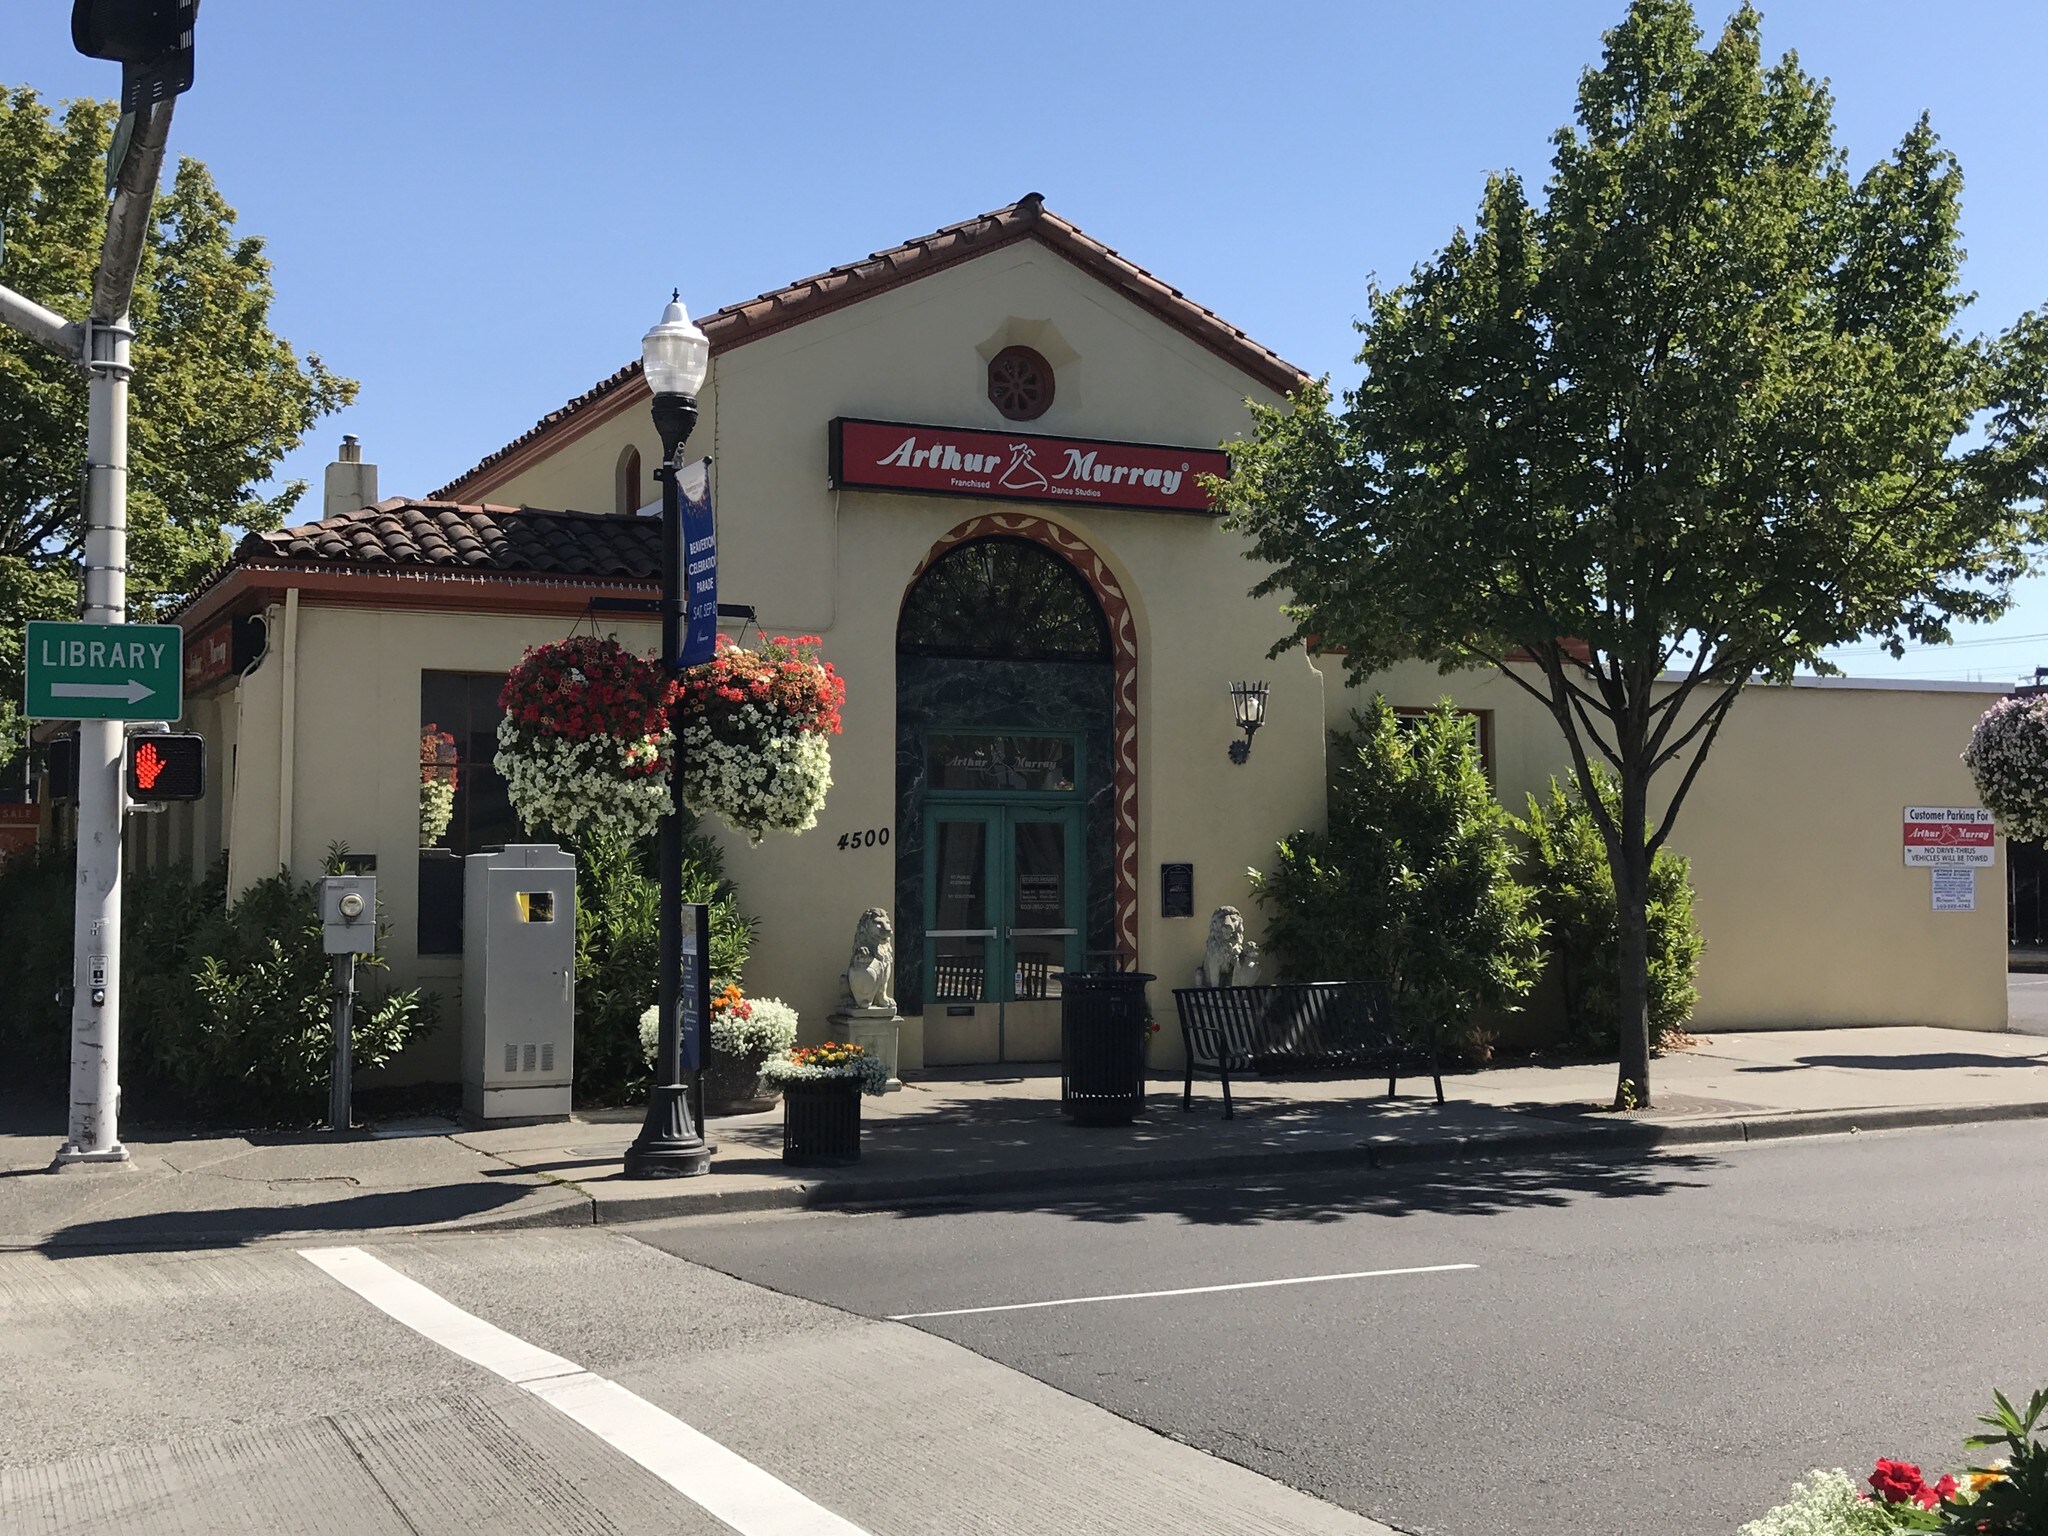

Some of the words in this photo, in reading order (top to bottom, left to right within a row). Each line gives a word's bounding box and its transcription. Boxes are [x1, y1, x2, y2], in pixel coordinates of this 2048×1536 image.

[876, 436, 1001, 474] Arthur
[950, 477, 991, 489] Franchised
[1051, 486, 1073, 496] Dance
[1074, 487, 1101, 497] Studios
[696, 577, 714, 593] PARADE
[703, 602, 712, 617] SEP
[42, 639, 166, 669] LIBRARY
[944, 756, 988, 767] Arthur
[1012, 756, 1057, 770] Murray
[1909, 809, 1945, 820] Customer
[1946, 809, 1975, 823] Parking
[1976, 810, 1989, 820] For
[837, 827, 890, 850] 4500
[1908, 828, 1941, 838] Arthur
[1957, 854, 1965, 862] BE
[1966, 854, 1988, 862] TOWED
